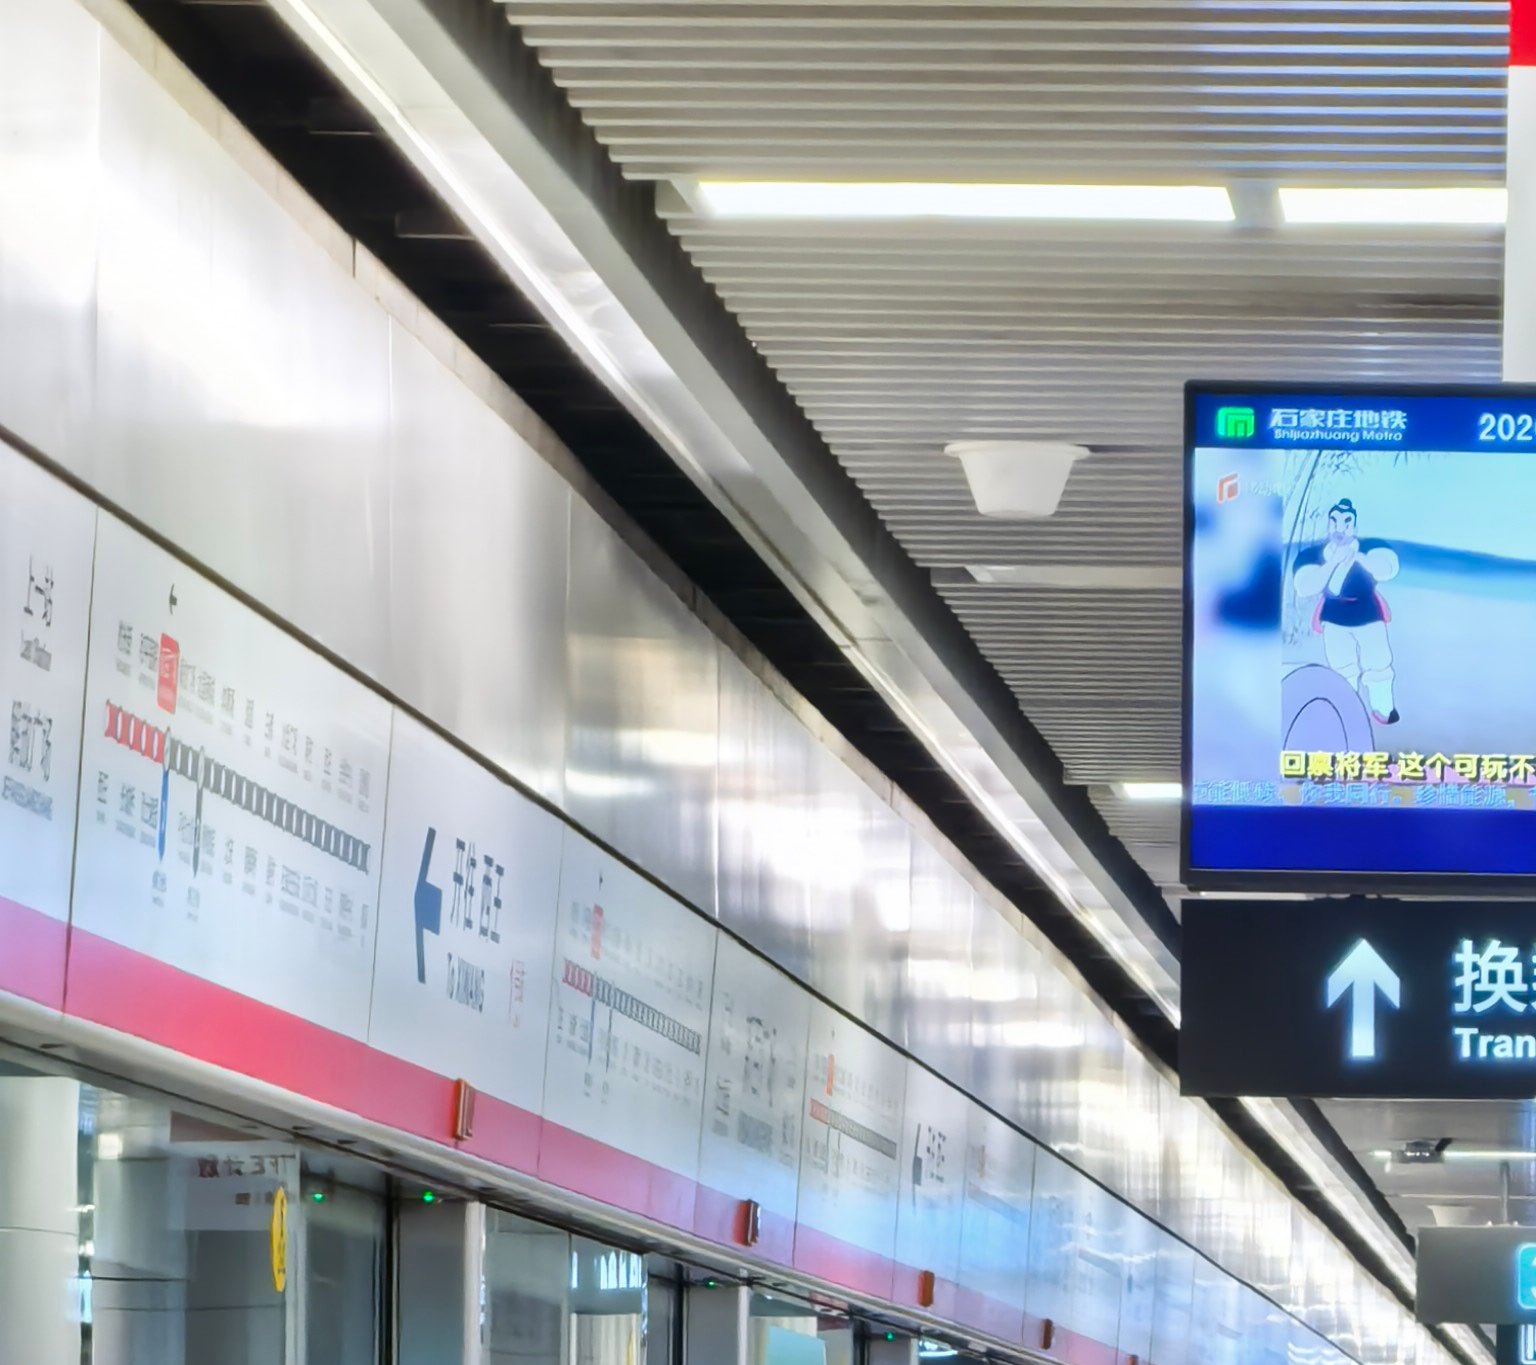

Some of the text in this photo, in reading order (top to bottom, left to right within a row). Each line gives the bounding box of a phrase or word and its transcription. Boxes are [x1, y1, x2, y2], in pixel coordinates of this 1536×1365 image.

[1270, 408, 1408, 430] 石家庄地铁
